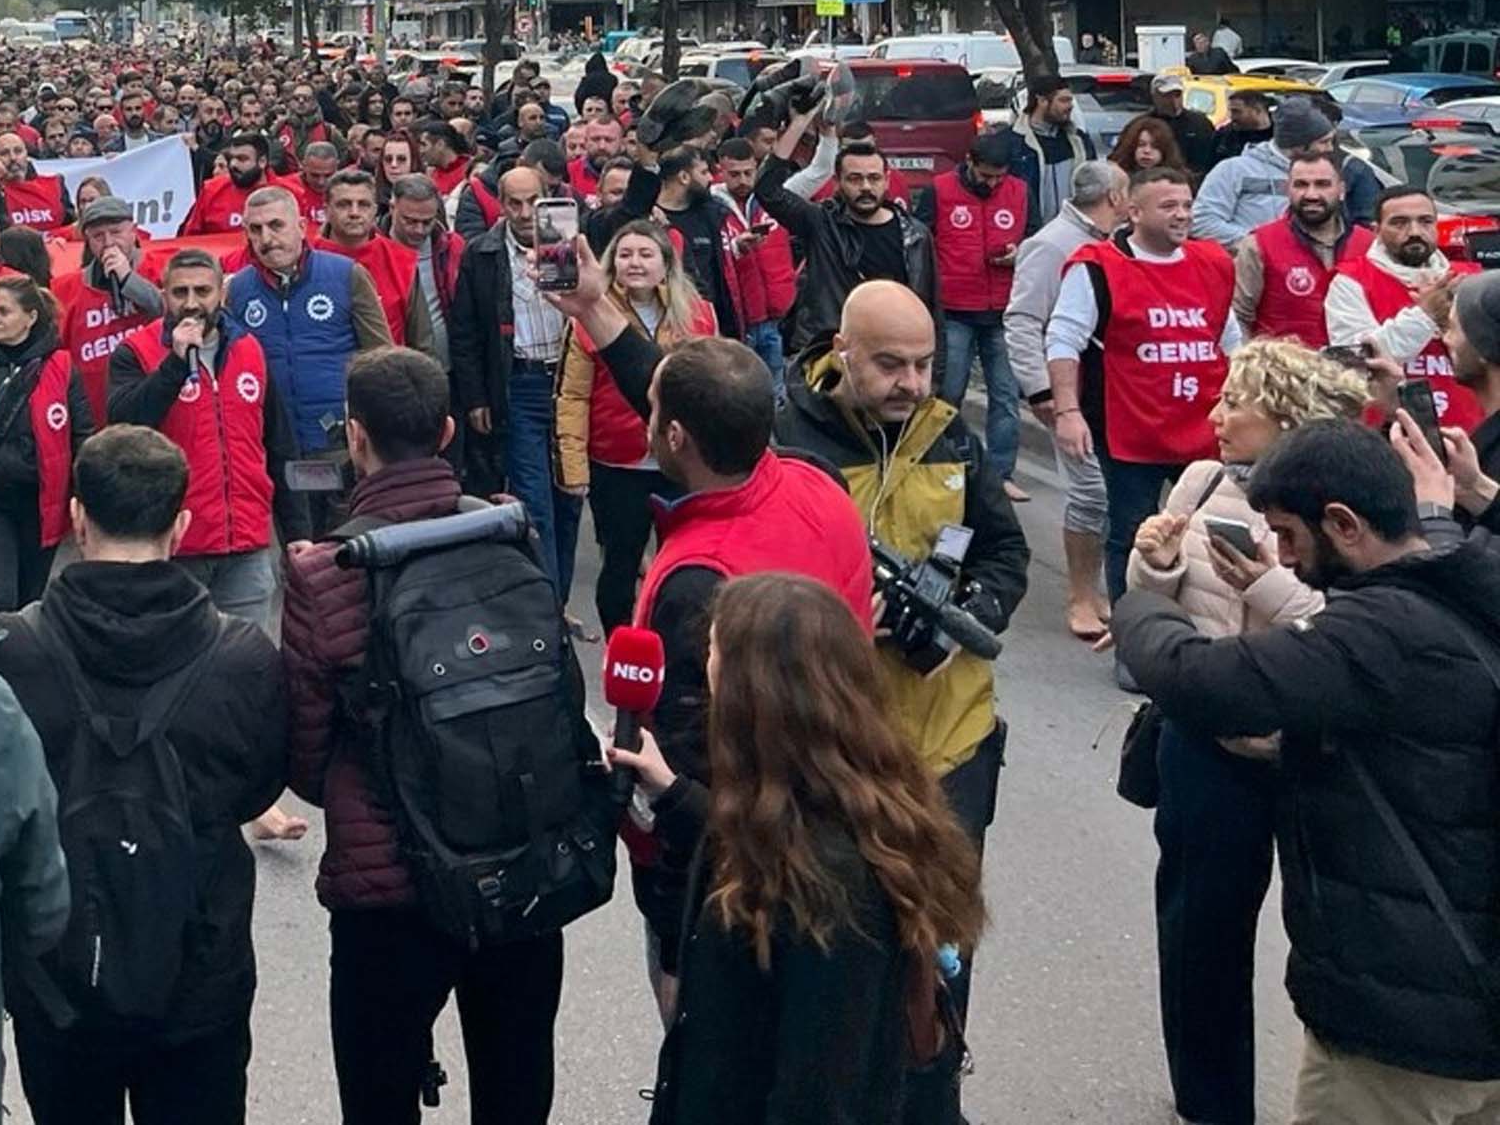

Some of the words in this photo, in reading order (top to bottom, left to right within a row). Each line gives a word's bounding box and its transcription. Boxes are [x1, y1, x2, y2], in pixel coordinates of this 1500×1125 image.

[11, 208, 54, 224] DİSK
[1147, 303, 1208, 328] DİSK
[1136, 342, 1218, 363] GENEL
[613, 662, 654, 683] NEO
